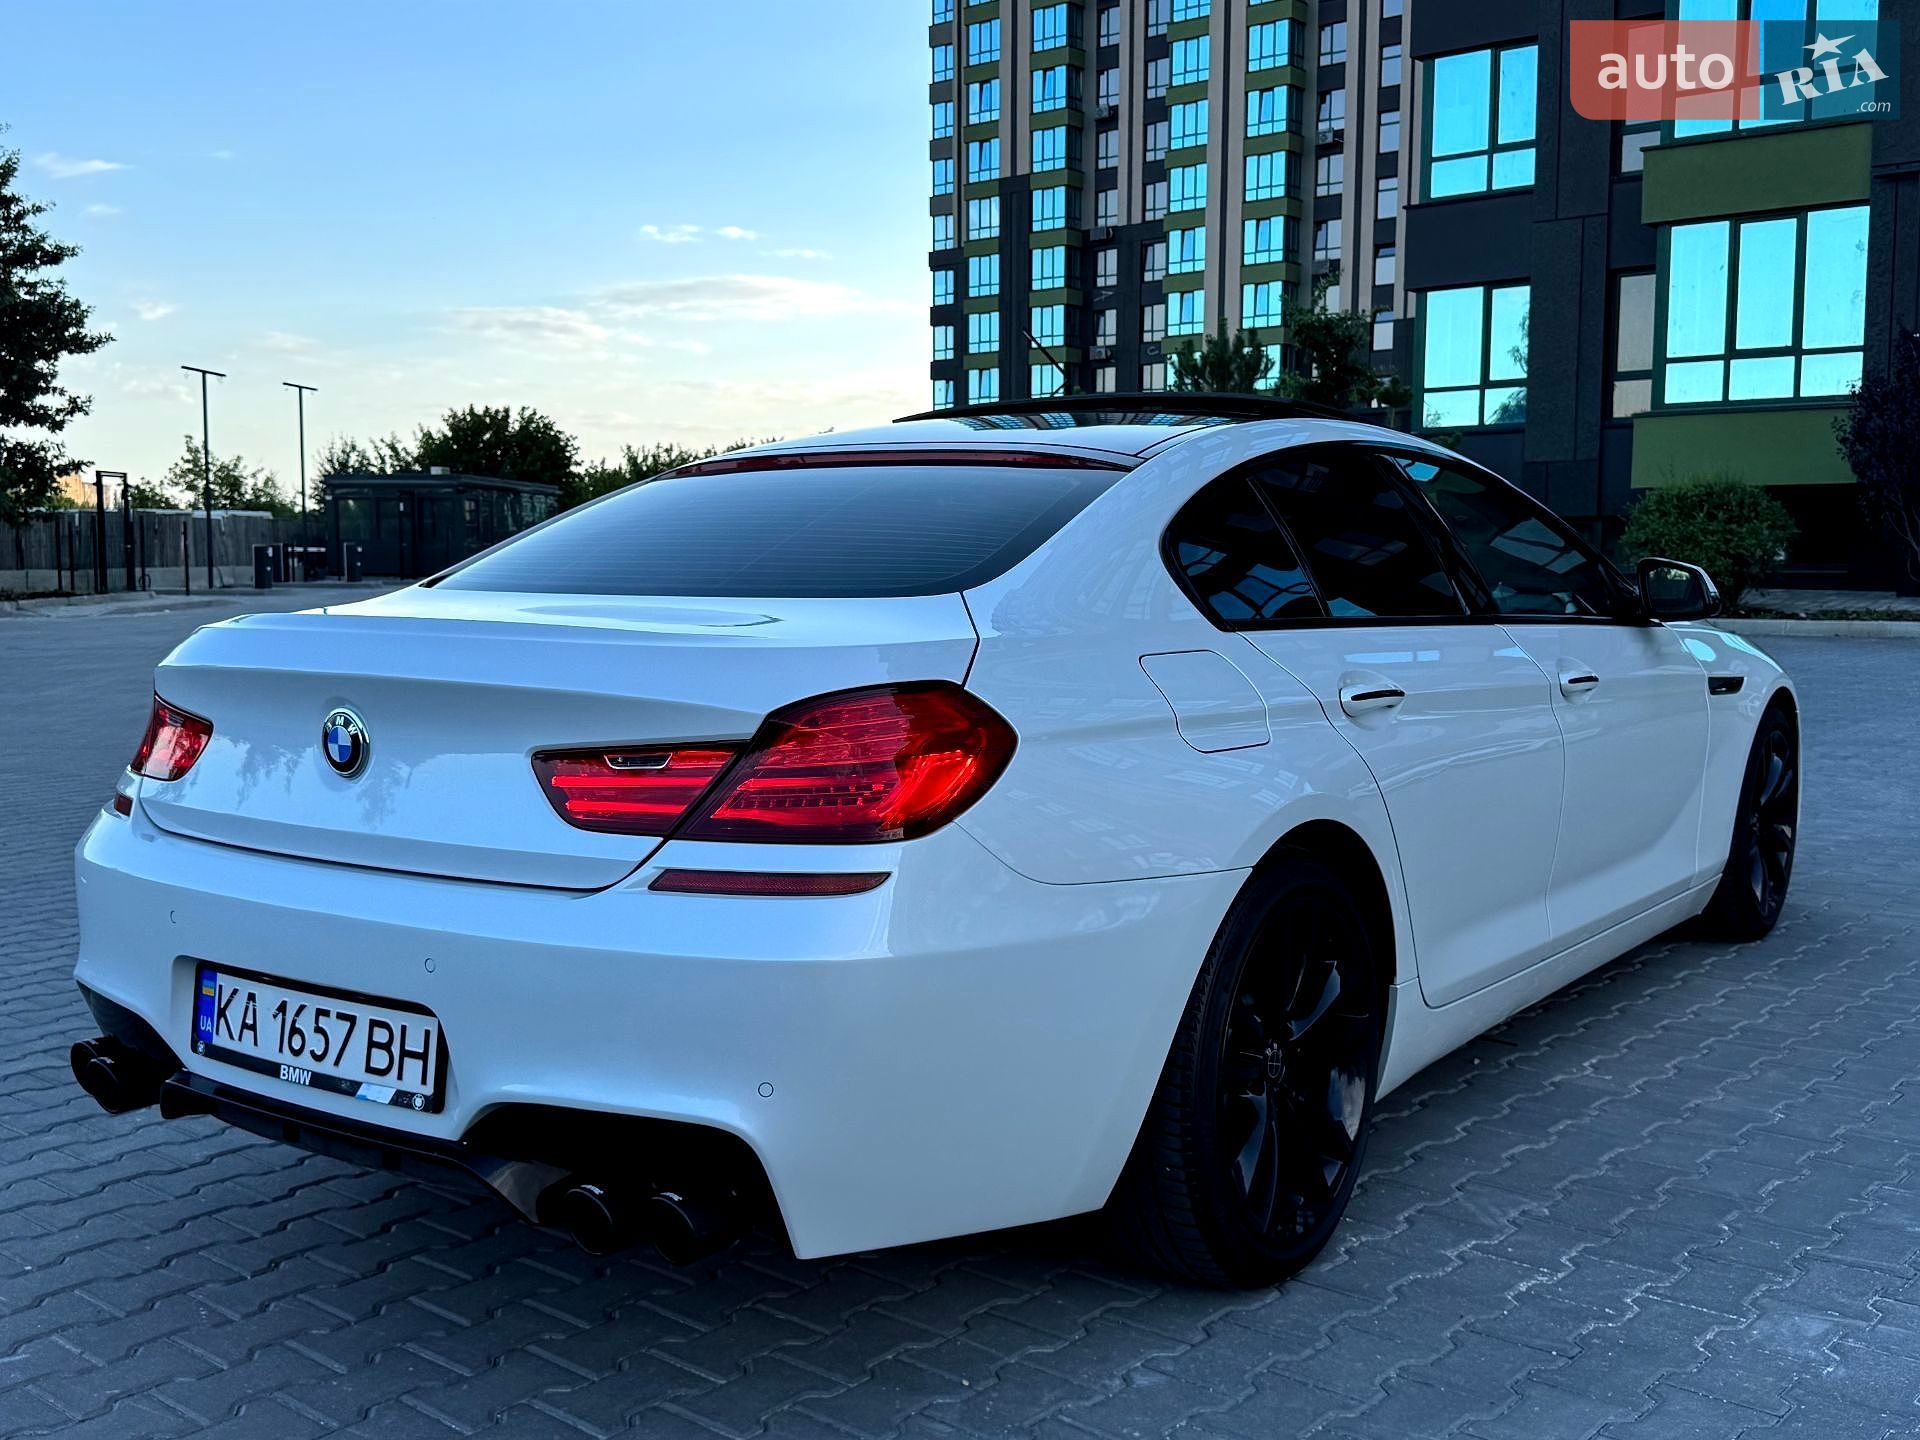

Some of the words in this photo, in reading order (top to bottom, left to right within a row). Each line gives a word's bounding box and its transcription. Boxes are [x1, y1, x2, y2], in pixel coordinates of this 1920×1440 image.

[200, 1014, 212, 1033] UA
[215, 984, 259, 1047] KA
[272, 1000, 357, 1068] 1657
[364, 1018, 431, 1086] BH
[279, 1064, 312, 1086] BMW
